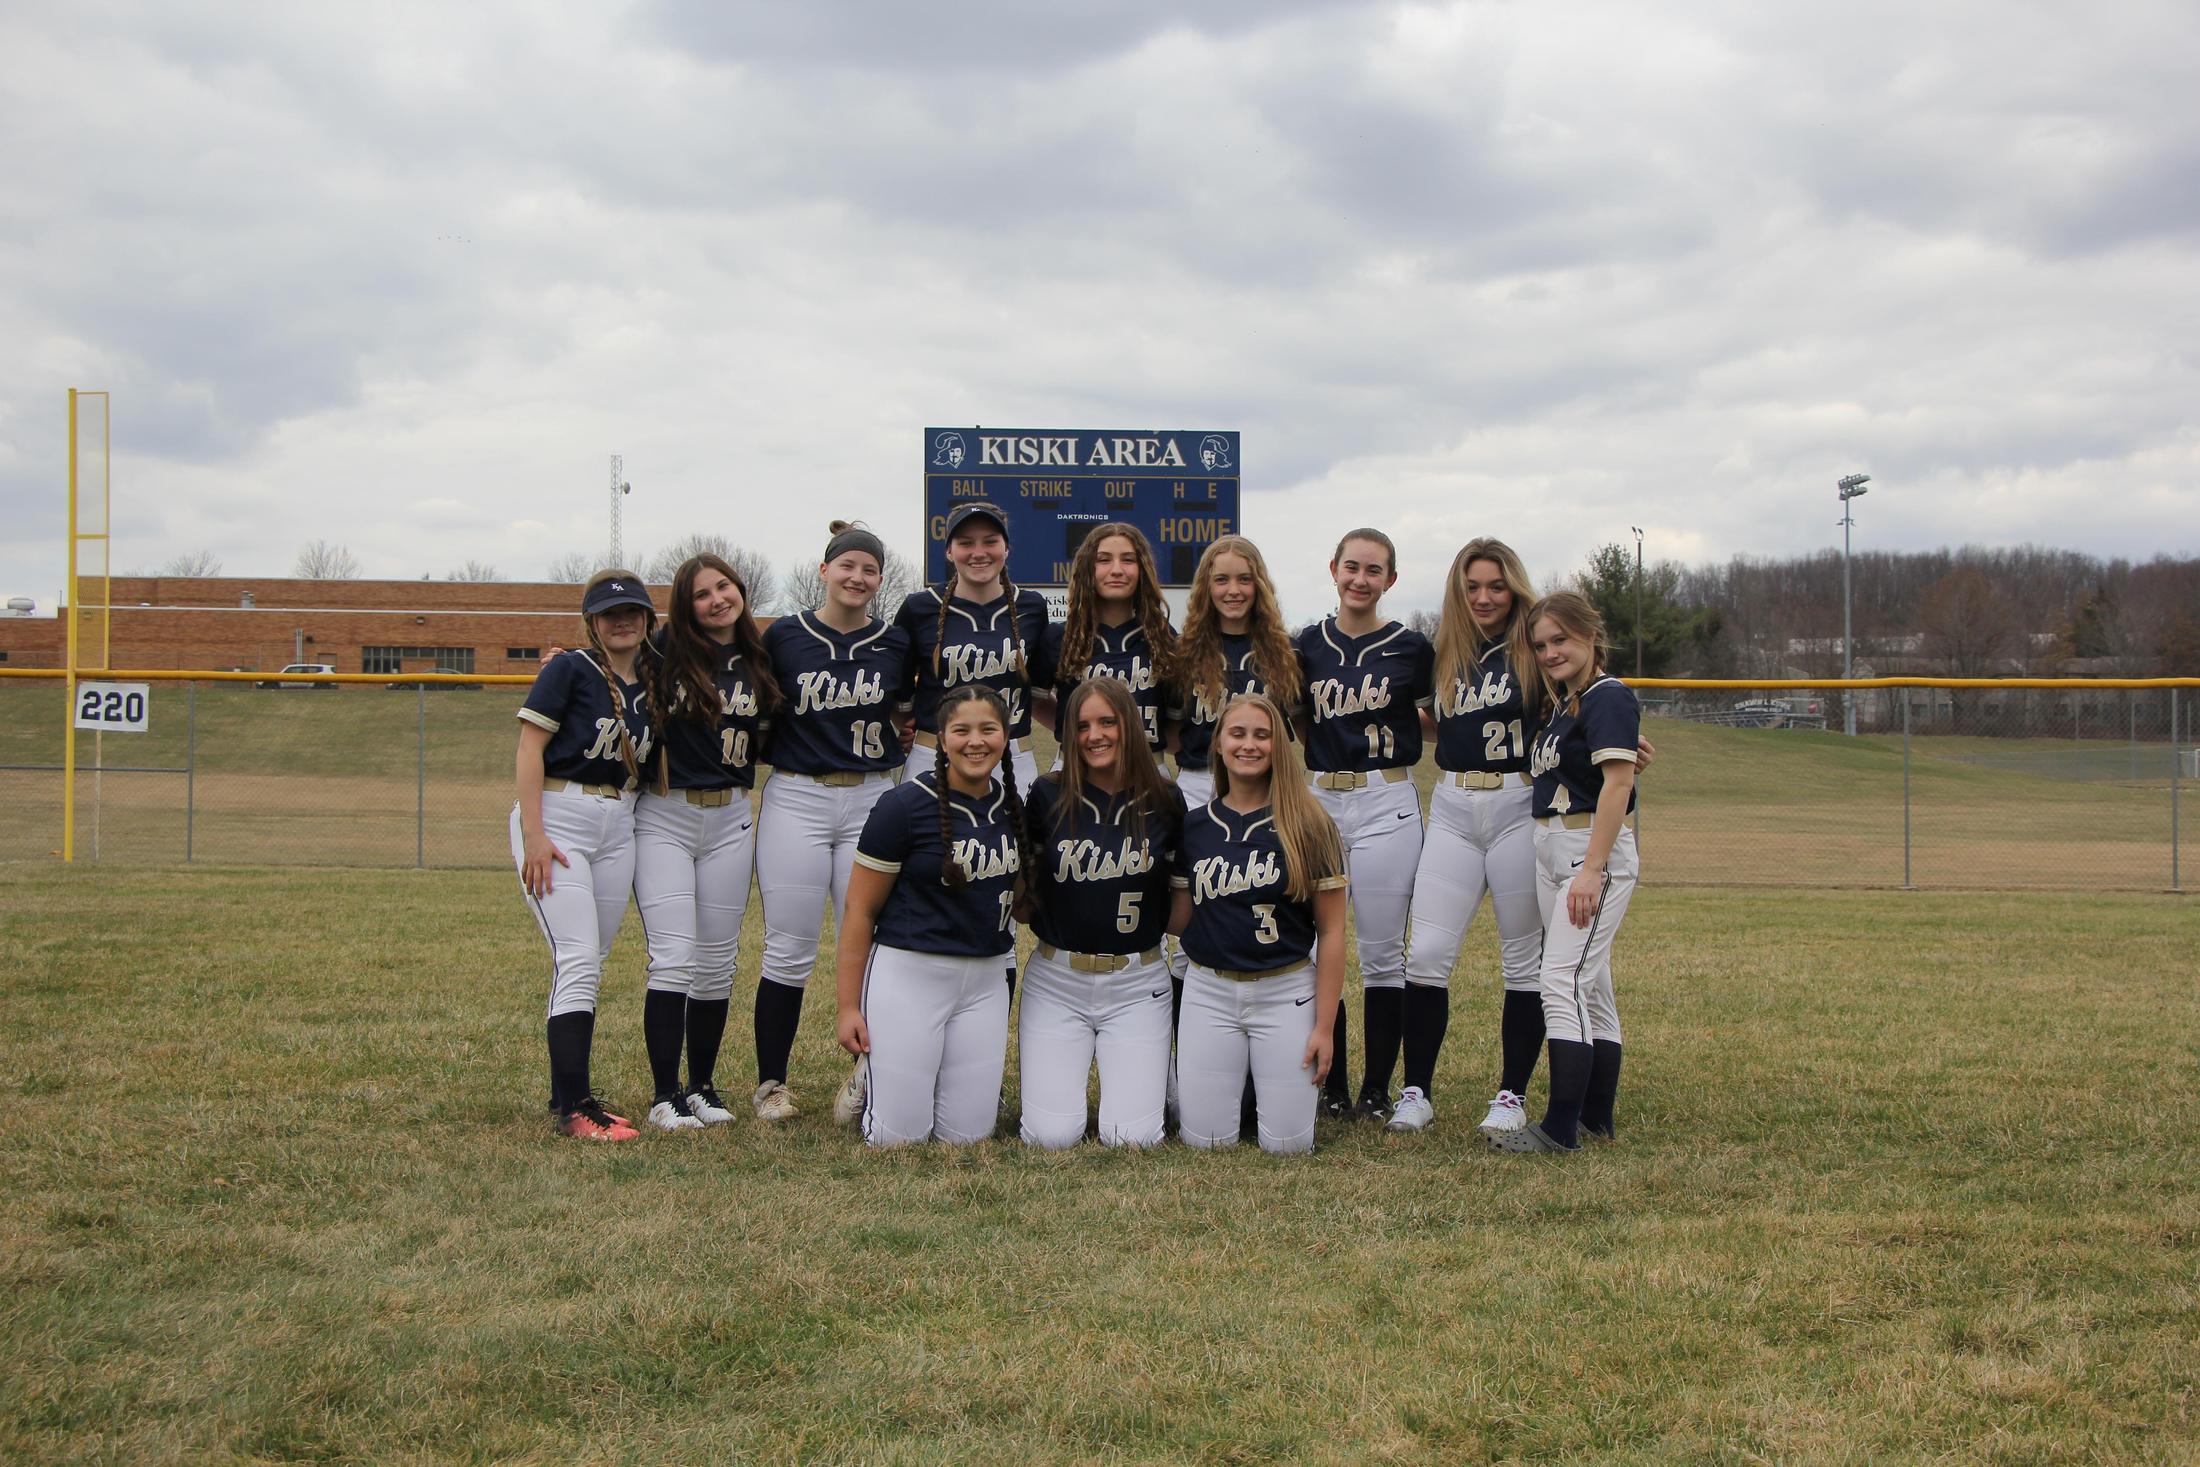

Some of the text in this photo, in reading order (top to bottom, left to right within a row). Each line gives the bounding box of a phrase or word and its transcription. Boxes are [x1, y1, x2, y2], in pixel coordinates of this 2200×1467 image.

[979, 436, 1187, 467] KISKI AREA
[952, 479, 988, 497] BALL
[1020, 480, 1072, 497] STRIKE
[1104, 481, 1136, 499] OUT
[1173, 481, 1185, 499] H
[1207, 482, 1217, 499] E
[1160, 518, 1232, 543] HOME
[81, 690, 144, 723] 220
[794, 668, 885, 715] Kiski
[1310, 673, 1392, 724] Kiski
[850, 720, 885, 759] 19
[1137, 704, 1160, 744] 3
[1364, 723, 1395, 759] 11
[1482, 718, 1524, 761] 21
[720, 727, 750, 768] 10
[1053, 836, 1155, 883] Kiski
[1193, 849, 1281, 905] Kiski
[1116, 891, 1144, 934] 5
[1252, 903, 1280, 945] 3
